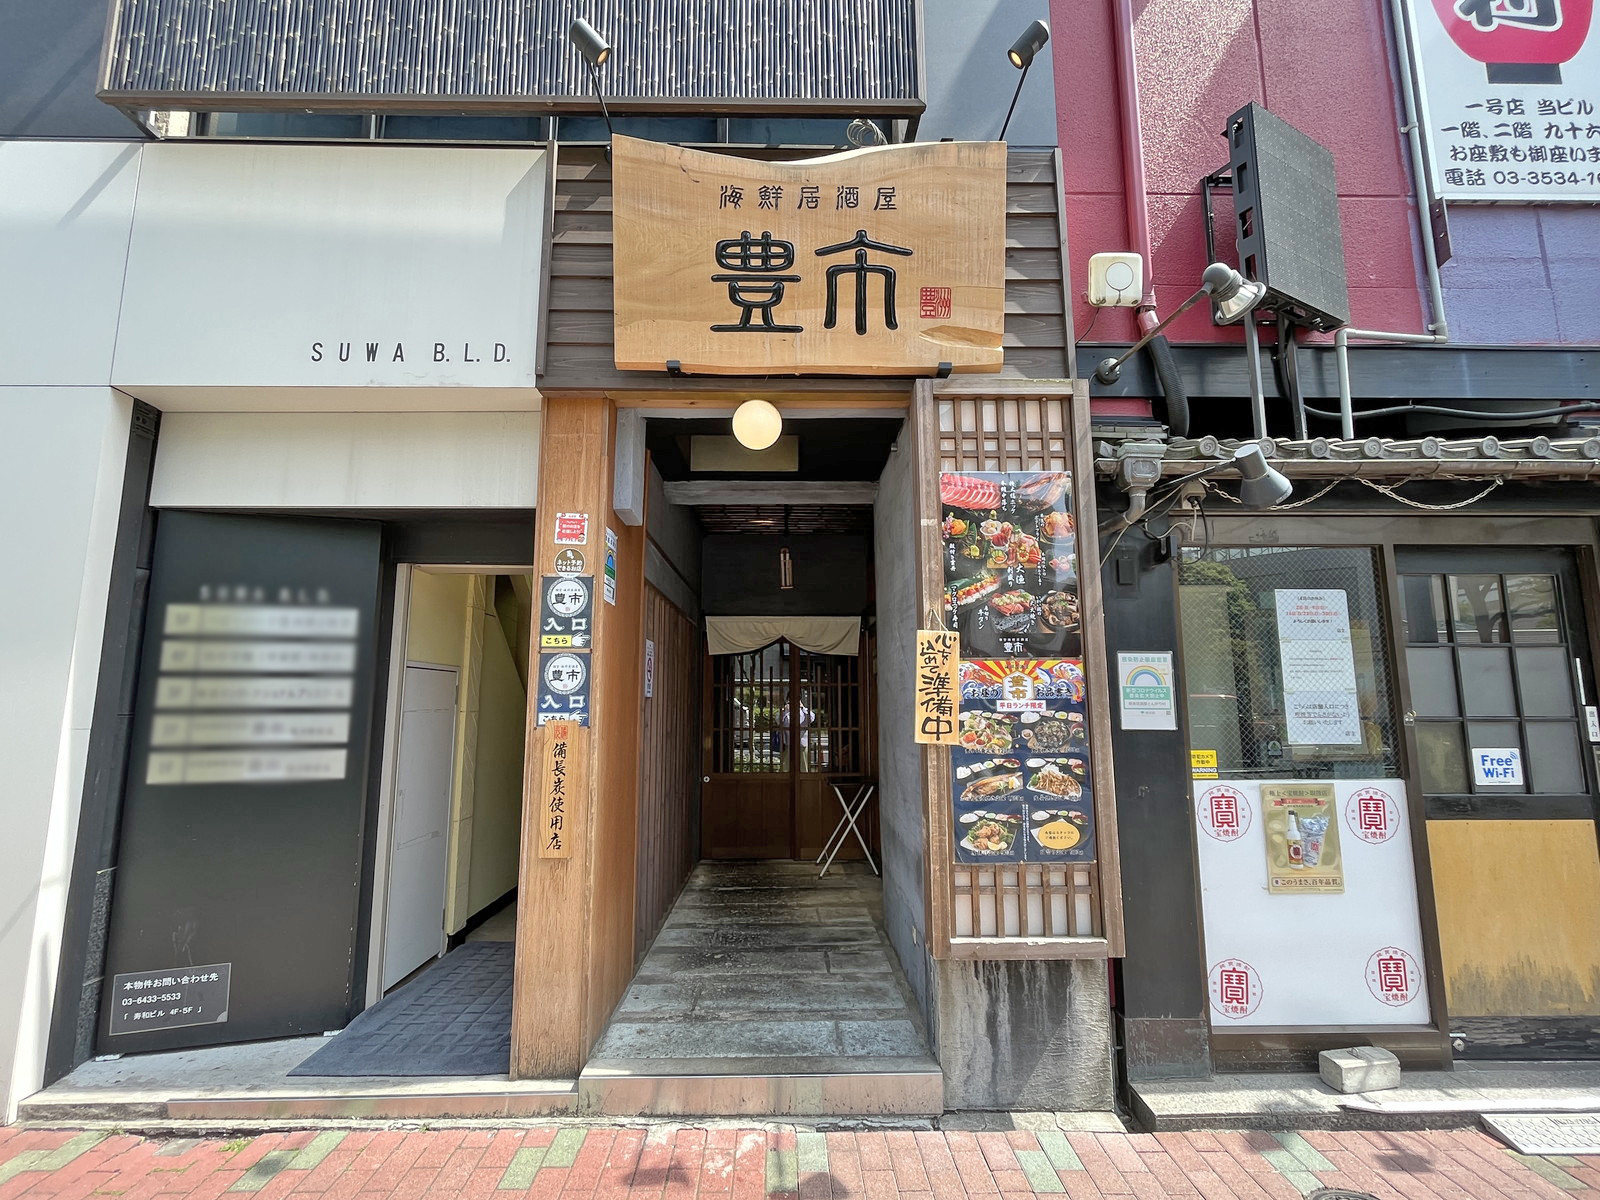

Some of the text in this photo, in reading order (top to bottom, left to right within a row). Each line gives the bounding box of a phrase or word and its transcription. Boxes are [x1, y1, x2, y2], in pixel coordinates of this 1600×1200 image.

[1465, 98, 1593, 116] 一号店 当ビル
[1441, 122, 1533, 139] 一階、二階
[1445, 169, 1600, 186] 電話 03-3534-1
[719, 185, 898, 211] 海鮮居酒屋
[709, 229, 913, 336] 豊市
[311, 342, 511, 362] SUWA B.L.D.
[1016, 563, 1026, 585] 大漁
[552, 592, 583, 606] 豊市
[543, 617, 588, 631] 入口
[1003, 641, 1024, 653] 豊市
[549, 669, 580, 682] 豊市
[971, 687, 999, 698] お昼の
[1008, 675, 1028, 700] 豊市
[541, 694, 586, 709] 入口
[918, 672, 953, 741] 準備中
[1588, 710, 1599, 738] 出入口
[1480, 754, 1513, 767] Free
[1483, 767, 1515, 779] Wi-Fi
[546, 742, 568, 851] 備長炭使用店
[1214, 829, 1239, 837] 宝焼酎
[1362, 831, 1387, 840] 宝焼酎
[123, 973, 219, 991] 本物件お問い合わせ先
[122, 992, 181, 1006] 03-6433-5533
[1383, 993, 1408, 1002] 宝焼酎
[1222, 1005, 1248, 1014] 宝焼酎
